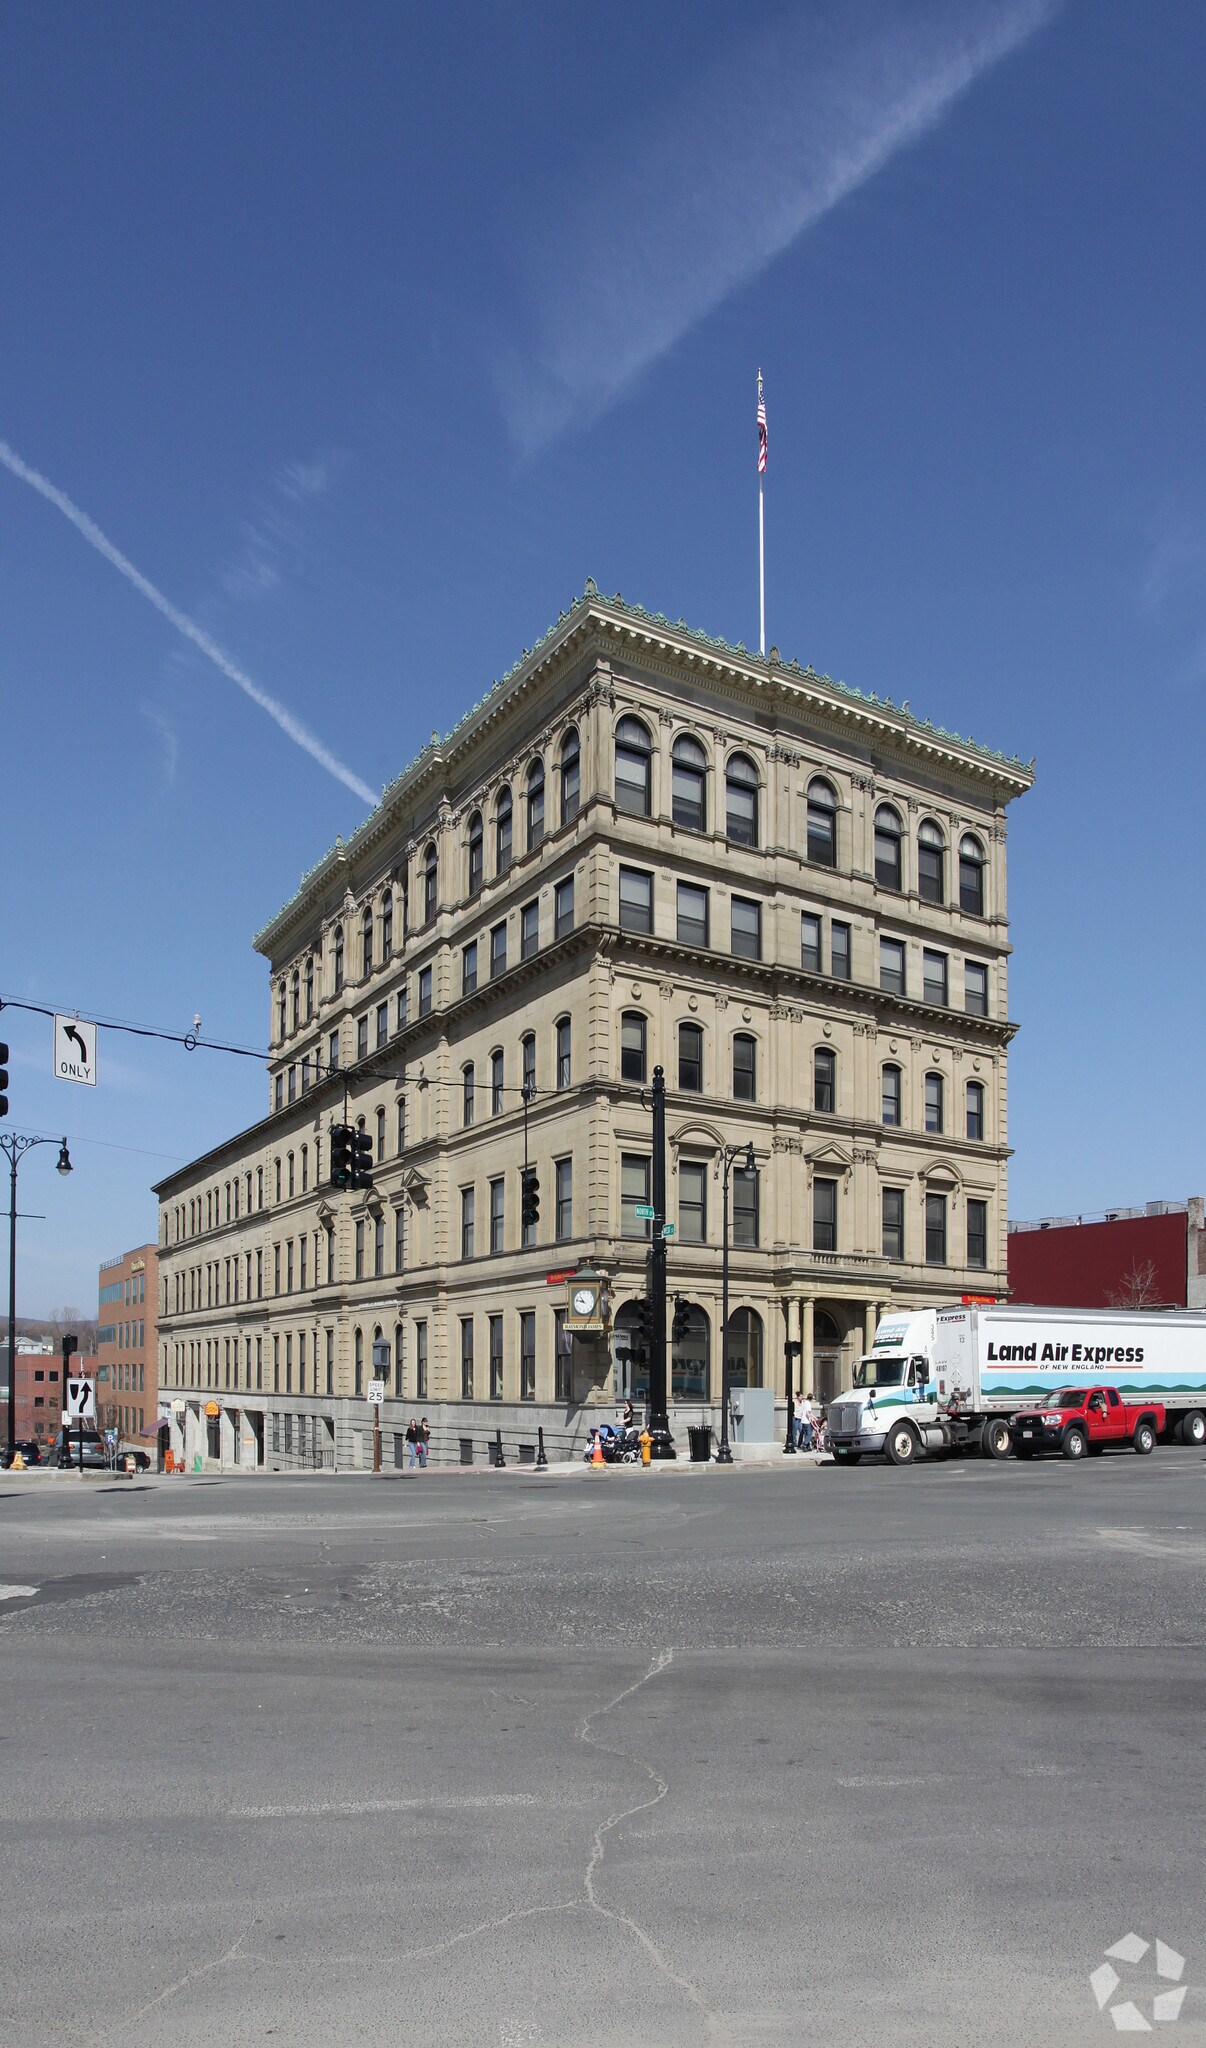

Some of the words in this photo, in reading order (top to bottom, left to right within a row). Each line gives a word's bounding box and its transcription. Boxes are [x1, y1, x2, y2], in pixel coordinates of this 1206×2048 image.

[61, 1062, 91, 1079] ONLY
[636, 1207, 649, 1216] NORTH
[940, 1313, 966, 1322] Express
[987, 1342, 1037, 1361] Land
[1040, 1343, 1069, 1361] Air
[1071, 1344, 1144, 1364] Express
[369, 1391, 383, 1401] 25
